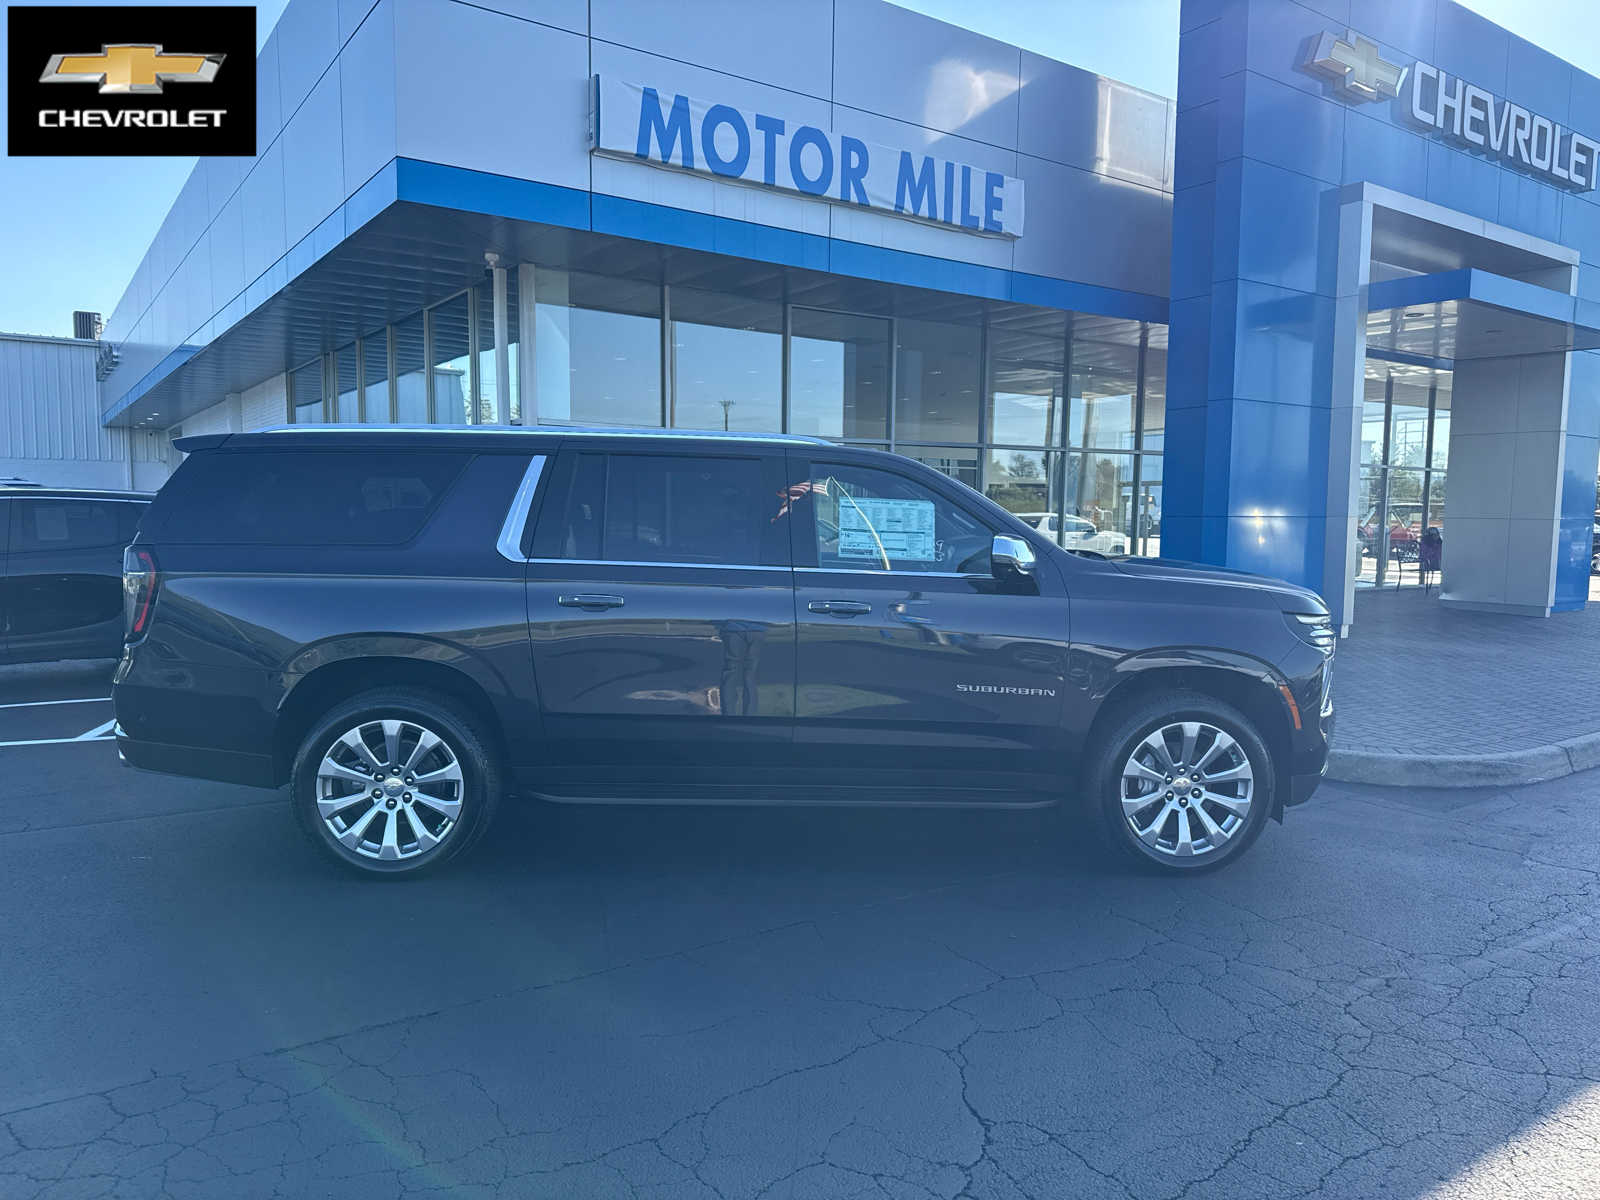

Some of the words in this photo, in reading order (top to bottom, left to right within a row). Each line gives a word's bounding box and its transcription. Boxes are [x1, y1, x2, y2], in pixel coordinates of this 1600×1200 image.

[635, 87, 870, 206] MOTOR
[895, 150, 1004, 233] MILE
[956, 684, 1056, 697] SUBURBAN
